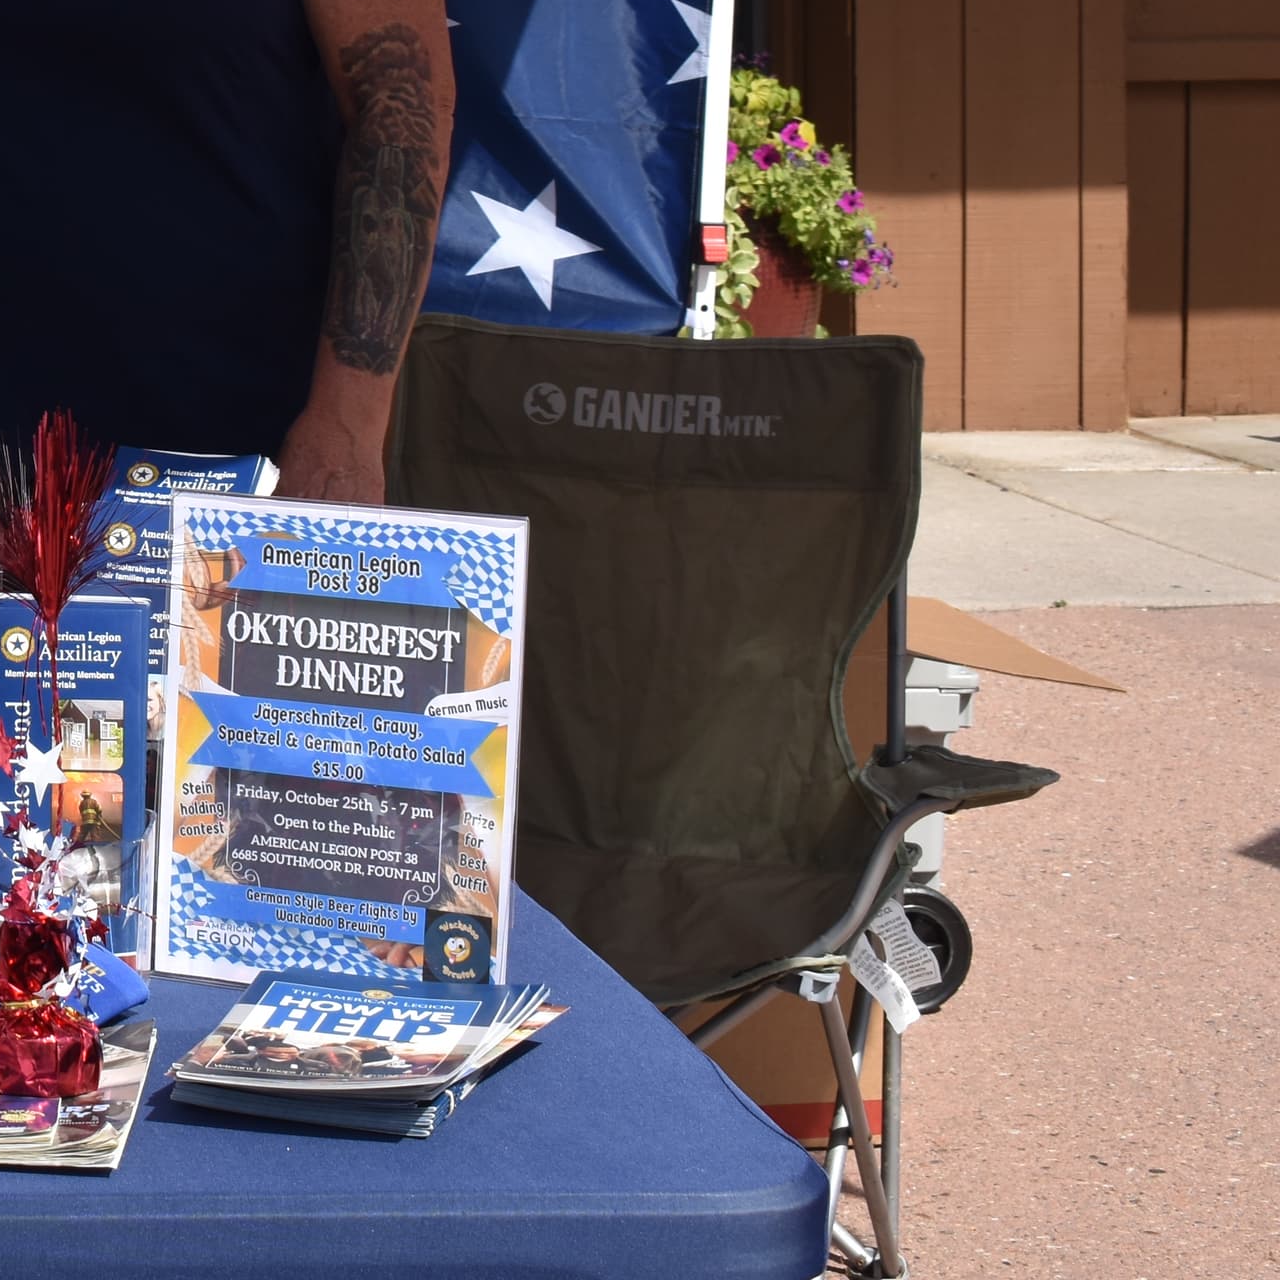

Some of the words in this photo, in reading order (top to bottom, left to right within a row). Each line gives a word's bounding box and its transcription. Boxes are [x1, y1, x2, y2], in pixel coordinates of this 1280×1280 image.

[573, 386, 722, 436] GANDER
[723, 415, 777, 438] MTN.
[157, 476, 234, 493] Auxiliary
[163, 468, 206, 478] American
[206, 471, 237, 480] Legion
[263, 544, 352, 570] American
[359, 552, 421, 580] Legion
[307, 569, 349, 592] Post
[357, 575, 380, 594] 38
[88, 631, 122, 644] Legion
[227, 610, 461, 663] OKTOBERFEST
[77, 670, 115, 680] Members
[276, 655, 405, 698] DINNER
[428, 703, 472, 717] German
[474, 696, 509, 712] Music
[254, 703, 368, 732] Jägerschnitzel,
[373, 715, 423, 738] Gravy,
[218, 725, 280, 747] Spaetzel
[286, 733, 299, 748] &
[304, 737, 362, 756] German
[368, 741, 417, 762] Potato
[422, 747, 465, 766] Salad
[312, 760, 363, 782] $15.00
[182, 782, 213, 796] Stein
[236, 783, 283, 804] Friday,
[285, 790, 339, 809] October
[342, 797, 373, 812] 25th
[380, 801, 388, 814] 5
[400, 804, 407, 816] 7
[411, 806, 434, 819] pm
[180, 799, 225, 817] holding
[463, 810, 496, 831] Prize
[179, 822, 225, 837] contest
[273, 814, 310, 833] Open
[312, 819, 325, 831] to
[328, 820, 350, 835] the
[353, 823, 396, 840] Public
[251, 834, 320, 855] AMERICAN
[322, 843, 368, 859] LEGION
[370, 849, 400, 863] POST
[404, 852, 418, 865] 38
[464, 833, 484, 849] for
[231, 848, 258, 862] 6685
[260, 853, 343, 874] SOUTHMOOR
[368, 864, 436, 884] FOUNTAIN
[459, 853, 487, 872] Best
[452, 874, 489, 893] Outfit
[246, 889, 291, 912] German
[294, 893, 324, 913] Style
[328, 898, 355, 914] Beer
[403, 909, 417, 925] by
[276, 909, 334, 930] Wackadoo
[338, 917, 386, 939] Brewing
[279, 995, 387, 1019] HOW
[388, 1007, 455, 1024] WE
[292, 988, 321, 998] THE
[402, 1000, 455, 1011] LEGION
[260, 1006, 448, 1043] HELP
